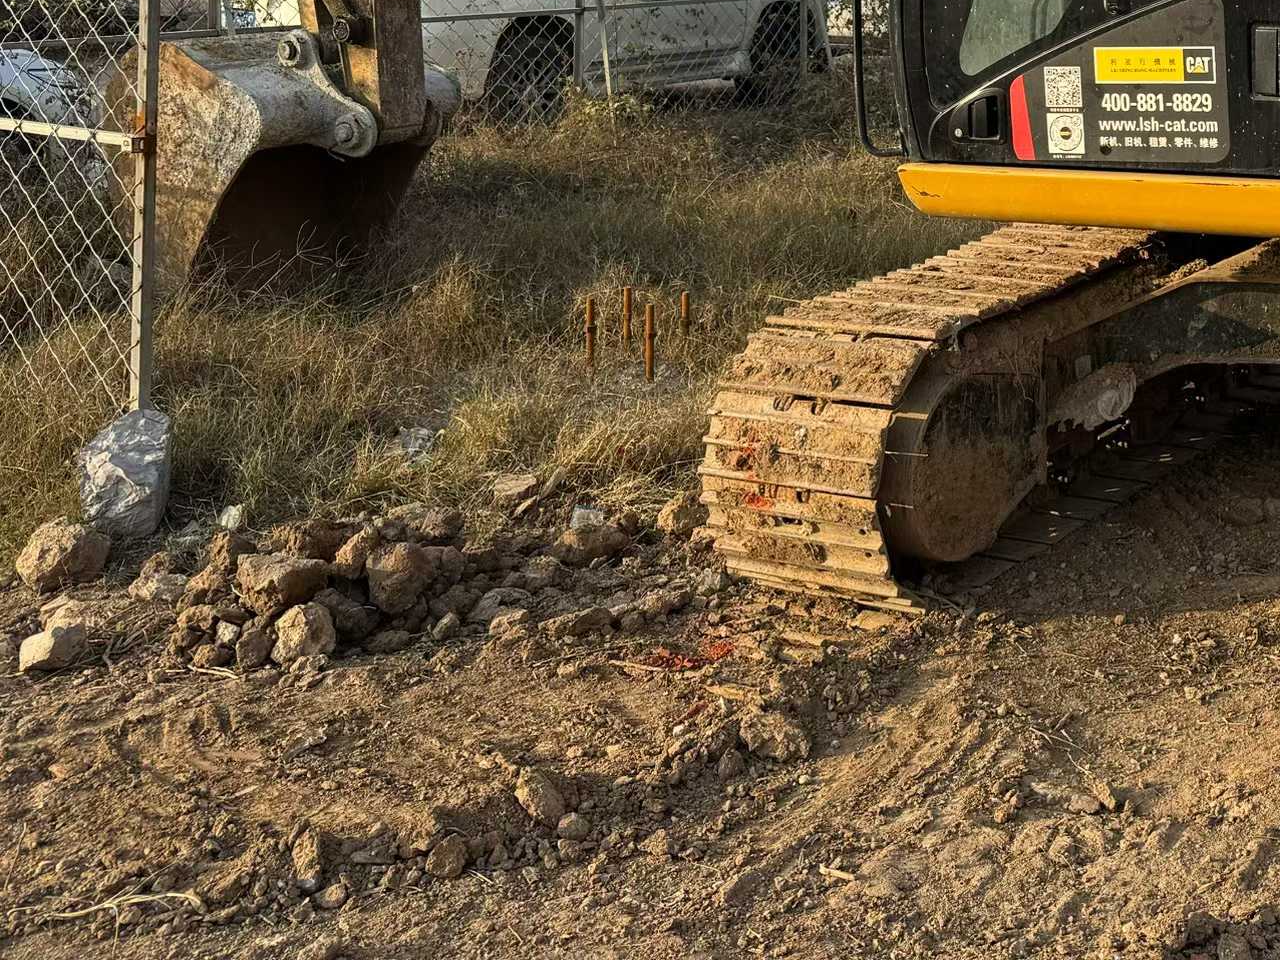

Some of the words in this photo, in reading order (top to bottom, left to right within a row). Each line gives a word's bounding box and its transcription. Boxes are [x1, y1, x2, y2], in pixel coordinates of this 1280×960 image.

[1186, 56, 1211, 74] CAT
[1101, 93, 1213, 113] 400-881-8829
[1098, 116, 1219, 133] www.lsh-cat.com
